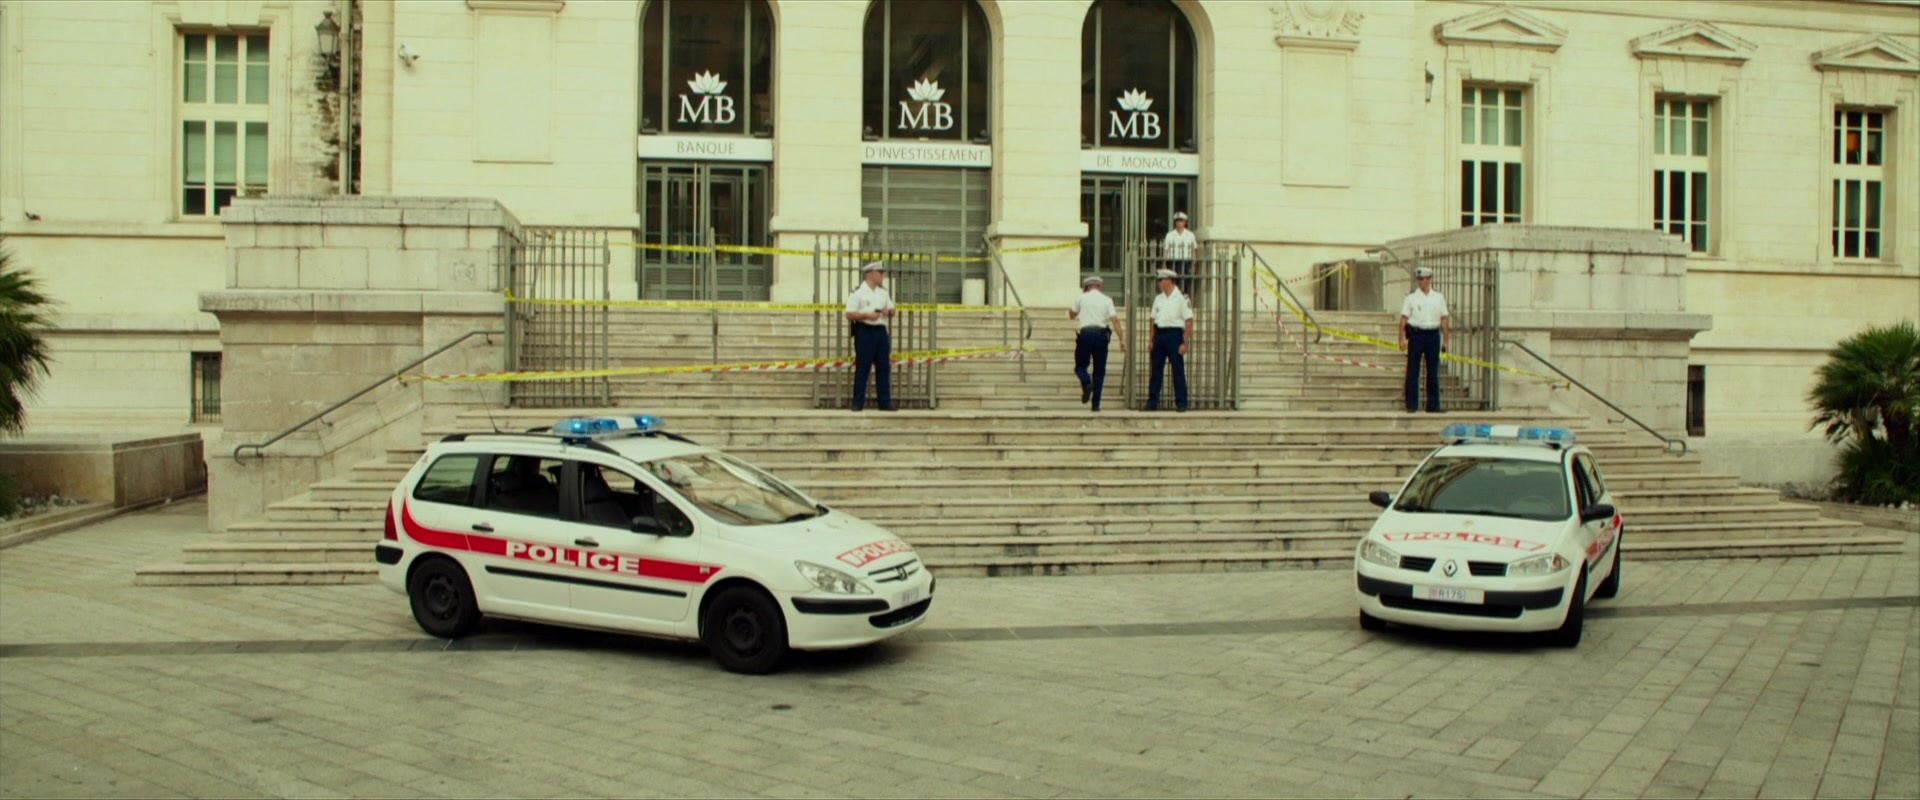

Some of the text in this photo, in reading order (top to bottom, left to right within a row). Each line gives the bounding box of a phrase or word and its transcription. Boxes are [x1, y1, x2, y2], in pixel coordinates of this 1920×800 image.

[677, 94, 736, 124] MB
[897, 101, 954, 131] MB
[1108, 110, 1162, 140] MB
[676, 140, 736, 155] BANQUE
[865, 146, 985, 161] D'INVESTISSEMENT
[1096, 154, 1177, 170] DE MONACO
[1407, 532, 1515, 549] POLICE
[505, 540, 640, 575] POLICE
